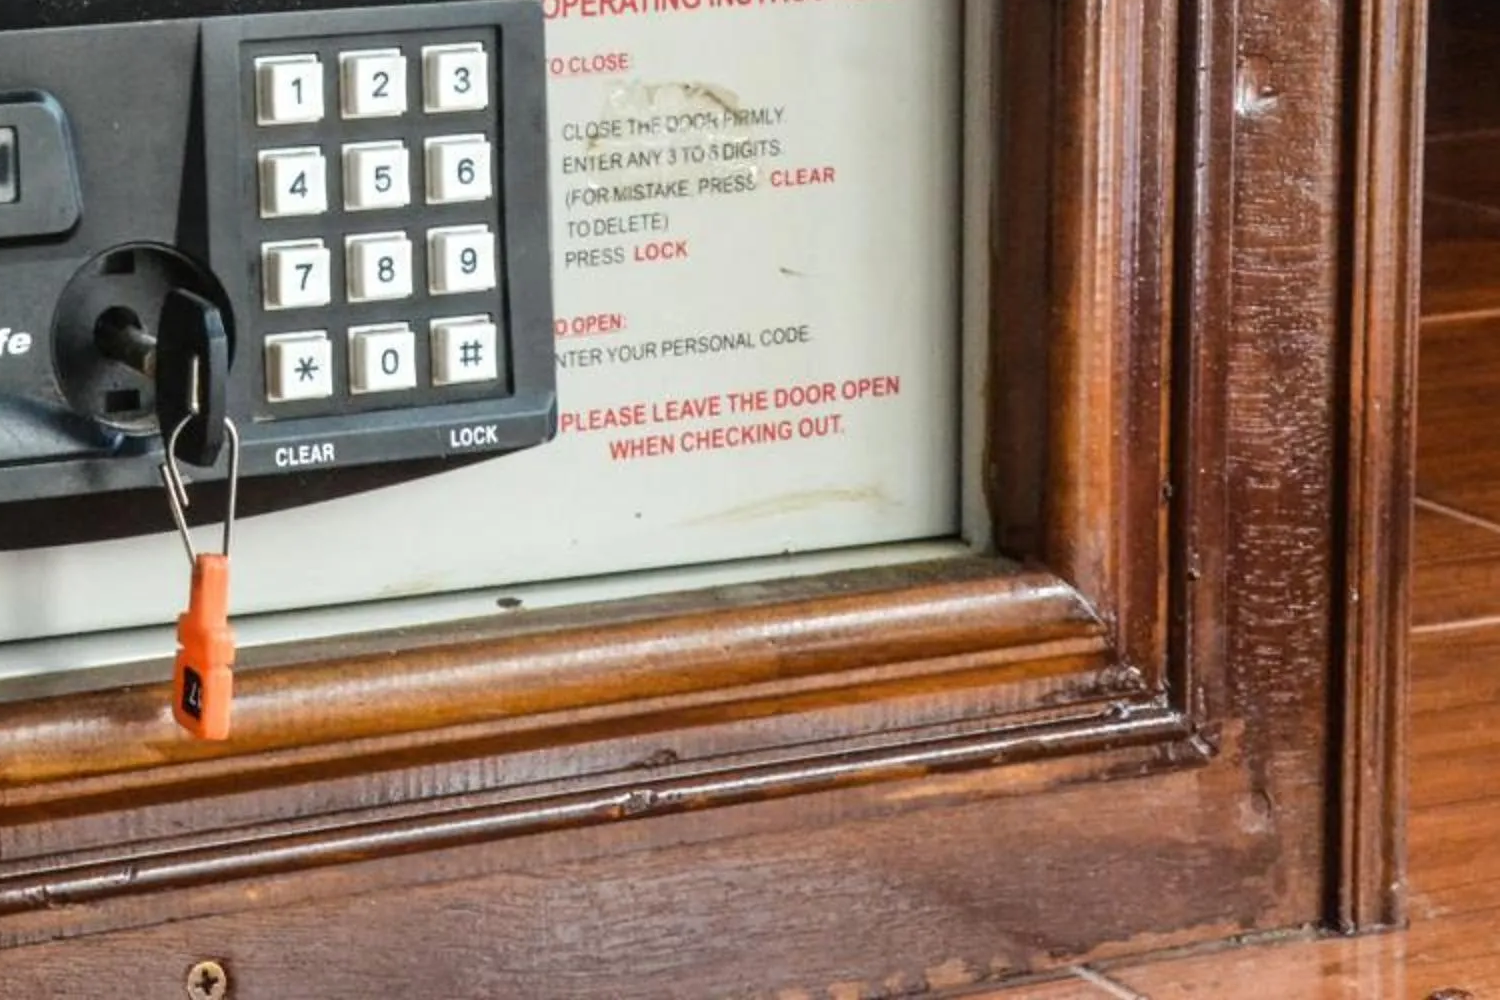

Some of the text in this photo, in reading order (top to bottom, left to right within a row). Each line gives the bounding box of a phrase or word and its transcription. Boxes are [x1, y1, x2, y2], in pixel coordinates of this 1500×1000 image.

[545, 57, 564, 75] O
[291, 78, 303, 105] 1
[371, 71, 389, 98] 2
[453, 67, 471, 93] 3
[563, 119, 622, 142] CLOSE
[457, 158, 475, 185] 6
[563, 151, 623, 174] ENTER
[627, 148, 662, 169] ANY
[667, 147, 678, 165] 3
[681, 145, 706, 163] TO
[288, 170, 308, 198] 4
[374, 165, 392, 193] 5
[699, 173, 756, 195] PRESS
[771, 167, 835, 188] CLEAR
[568, 211, 669, 238] TO DELETE)
[460, 247, 478, 274] 9
[564, 240, 688, 269] PRESS LOCK
[295, 263, 313, 291] 7
[377, 256, 395, 283] 8
[381, 349, 399, 375] 0
[460, 339, 483, 367] #
[555, 347, 603, 369] NTER
[607, 340, 657, 363] YOUR
[661, 332, 756, 357] PERSONAL
[560, 375, 901, 433] PLEASE LEAVE THE DOOR OPEN
[450, 424, 498, 447] LOCK
[609, 432, 676, 461] WHEN
[680, 420, 793, 453] CHECKING
[275, 442, 335, 467] CLEAR
